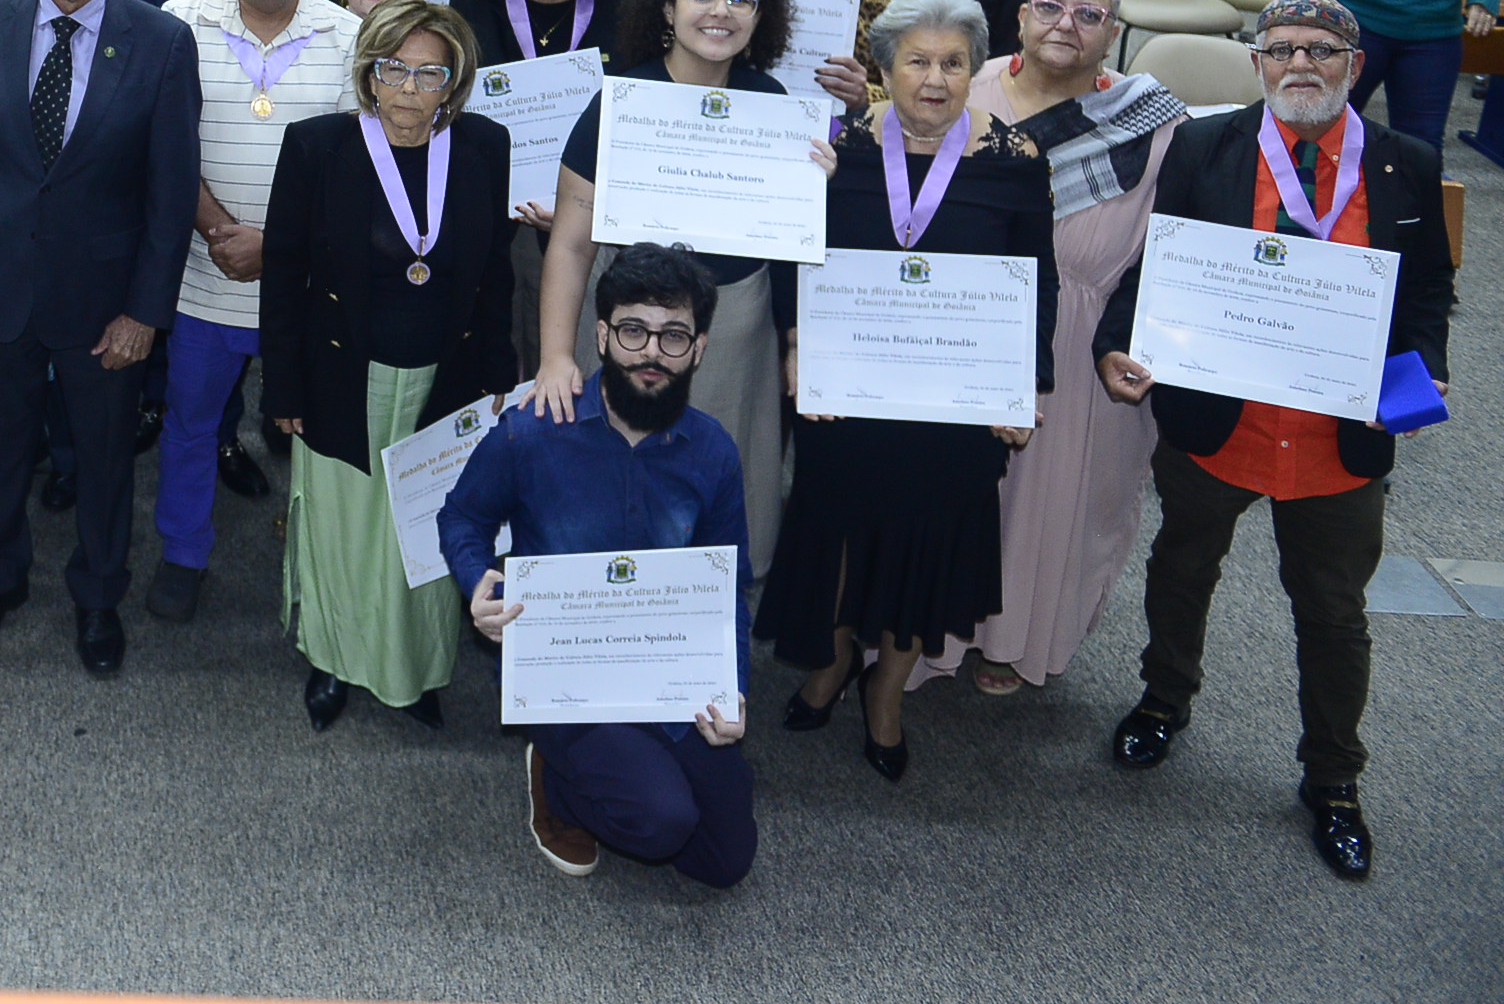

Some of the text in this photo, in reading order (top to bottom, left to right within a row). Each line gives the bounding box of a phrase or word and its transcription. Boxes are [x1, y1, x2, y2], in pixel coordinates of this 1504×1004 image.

[493, 86, 591, 109] da Cultura Júlio Vilela
[527, 103, 556, 113] Goiânia
[616, 113, 812, 144] Medalha do Mérito da Cultura Júlio Vilela
[512, 136, 558, 149] dos Santos
[657, 165, 765, 184] Giulia Chalub Santoro
[1161, 251, 1376, 299] Medalha do Mérito da Cultura Júlio Vilela
[815, 283, 1019, 303] Medalha do Mérito da Cultura Júlio Vilela
[1202, 270, 1236, 284] Câmara
[1236, 276, 1282, 292] Municipal
[1282, 285, 1293, 295] de
[1293, 287, 1330, 302] Goiânia
[854, 297, 977, 312] Câmara Municipal de Goiânia
[1223, 309, 1255, 324] Pedro
[1257, 316, 1295, 331] Galvão
[935, 336, 978, 348] Brandão
[398, 461, 428, 482] Medalha
[520, 583, 720, 602] Medalha do Mérito da Cultura Júlio Vilela
[559, 597, 679, 611] Câmara Municipal de Goiânia
[549, 636, 573, 646] Jean
[574, 636, 603, 645] Lucas
[605, 634, 642, 644] Correia
